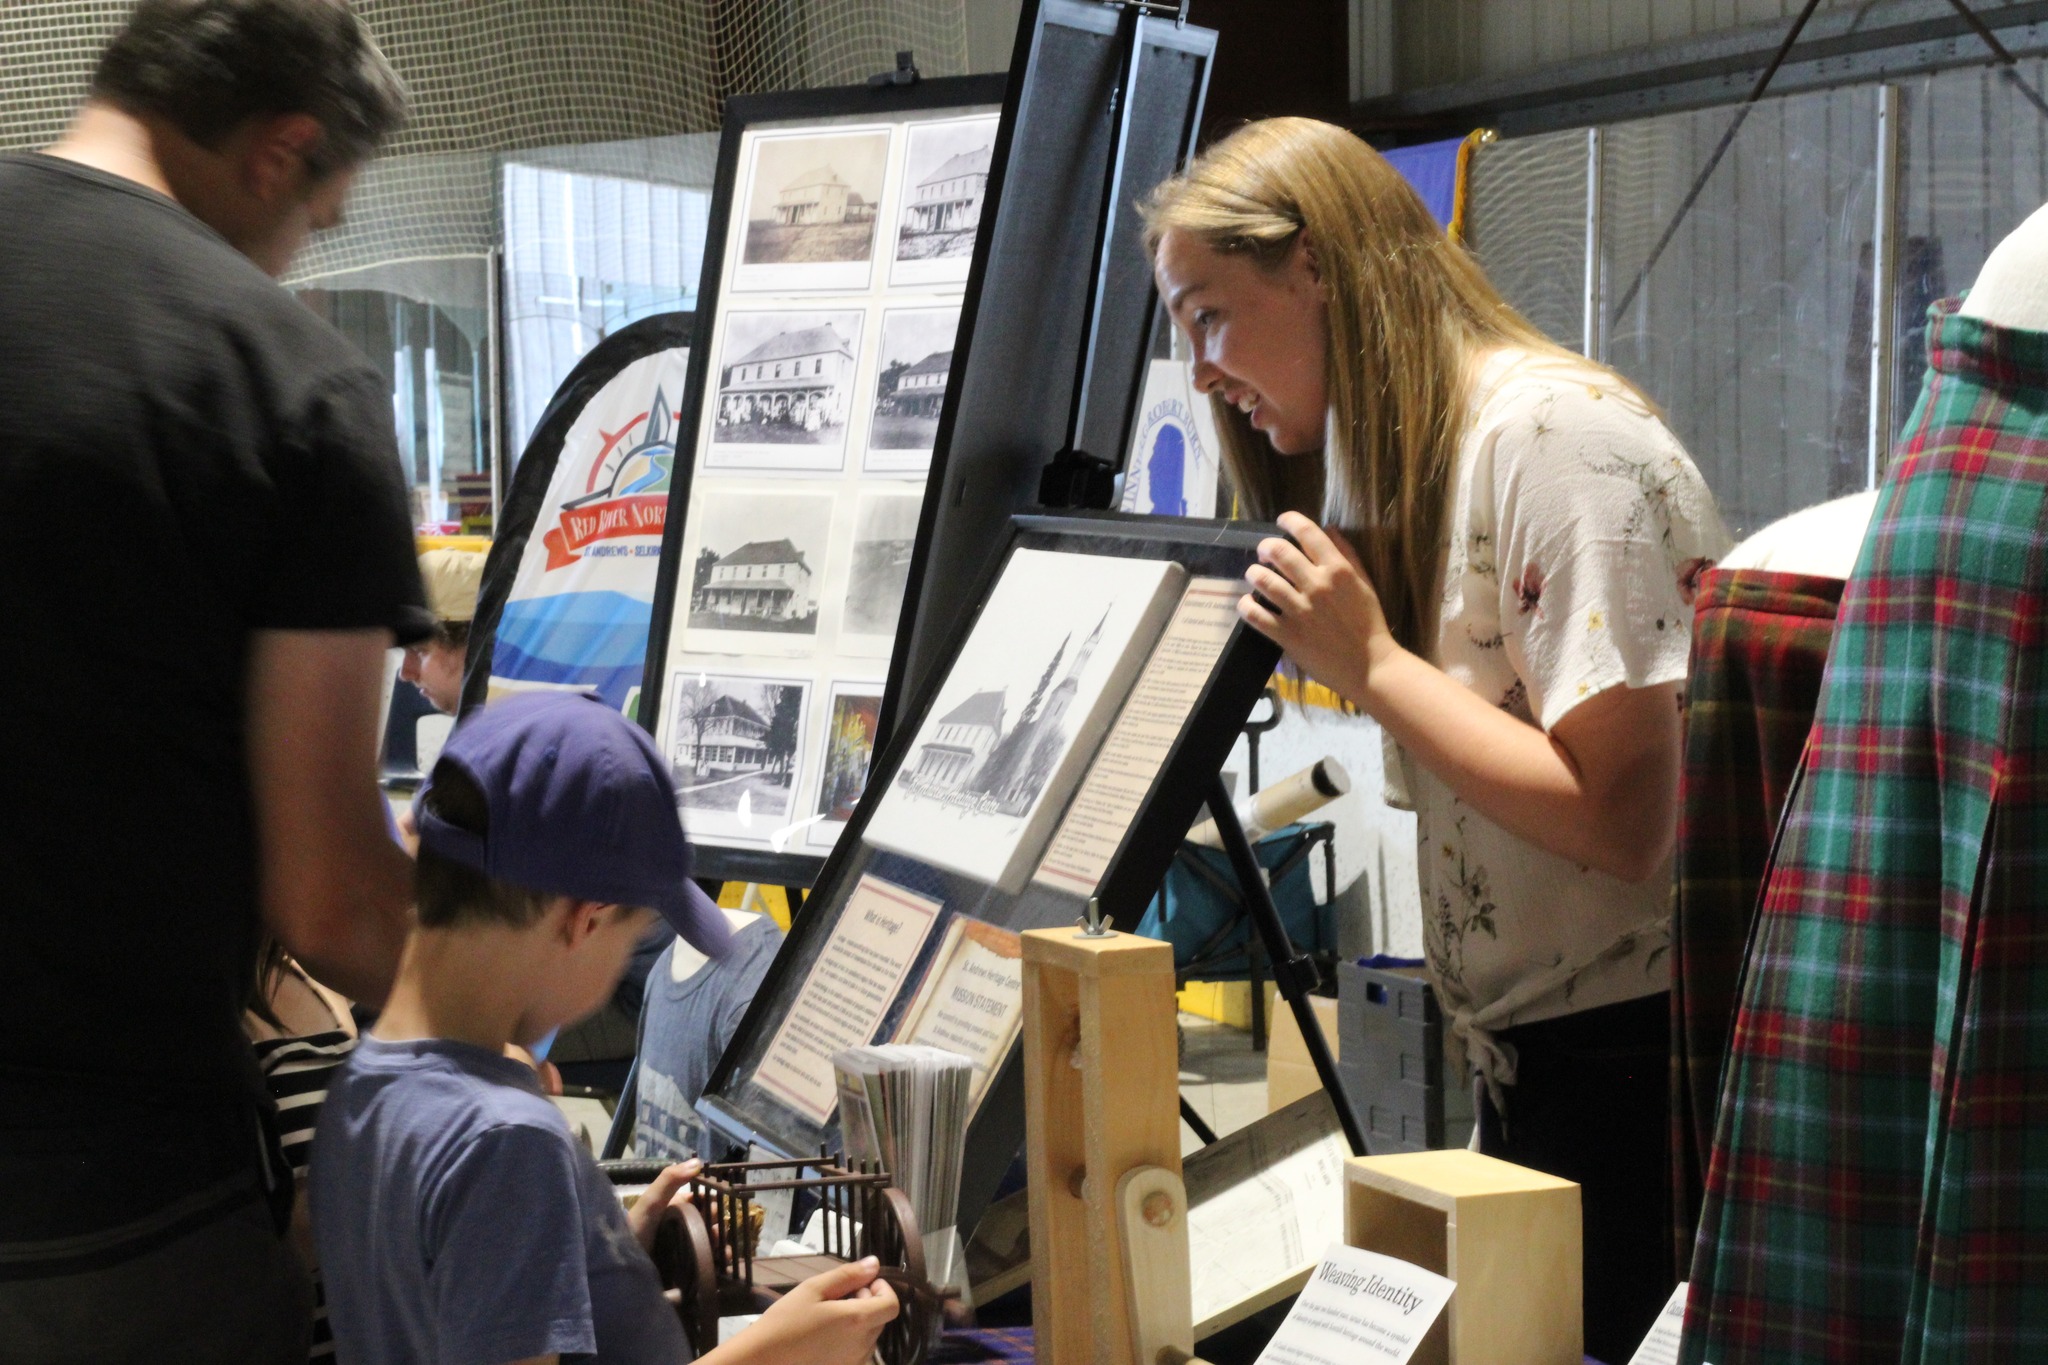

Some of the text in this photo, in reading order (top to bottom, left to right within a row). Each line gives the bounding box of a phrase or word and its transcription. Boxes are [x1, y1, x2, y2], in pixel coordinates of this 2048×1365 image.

[570, 516, 597, 542] RED
[973, 994, 1008, 1017] STATEMENT
[1318, 1260, 1367, 1296] Weaving
[1362, 1274, 1424, 1315] Identity
